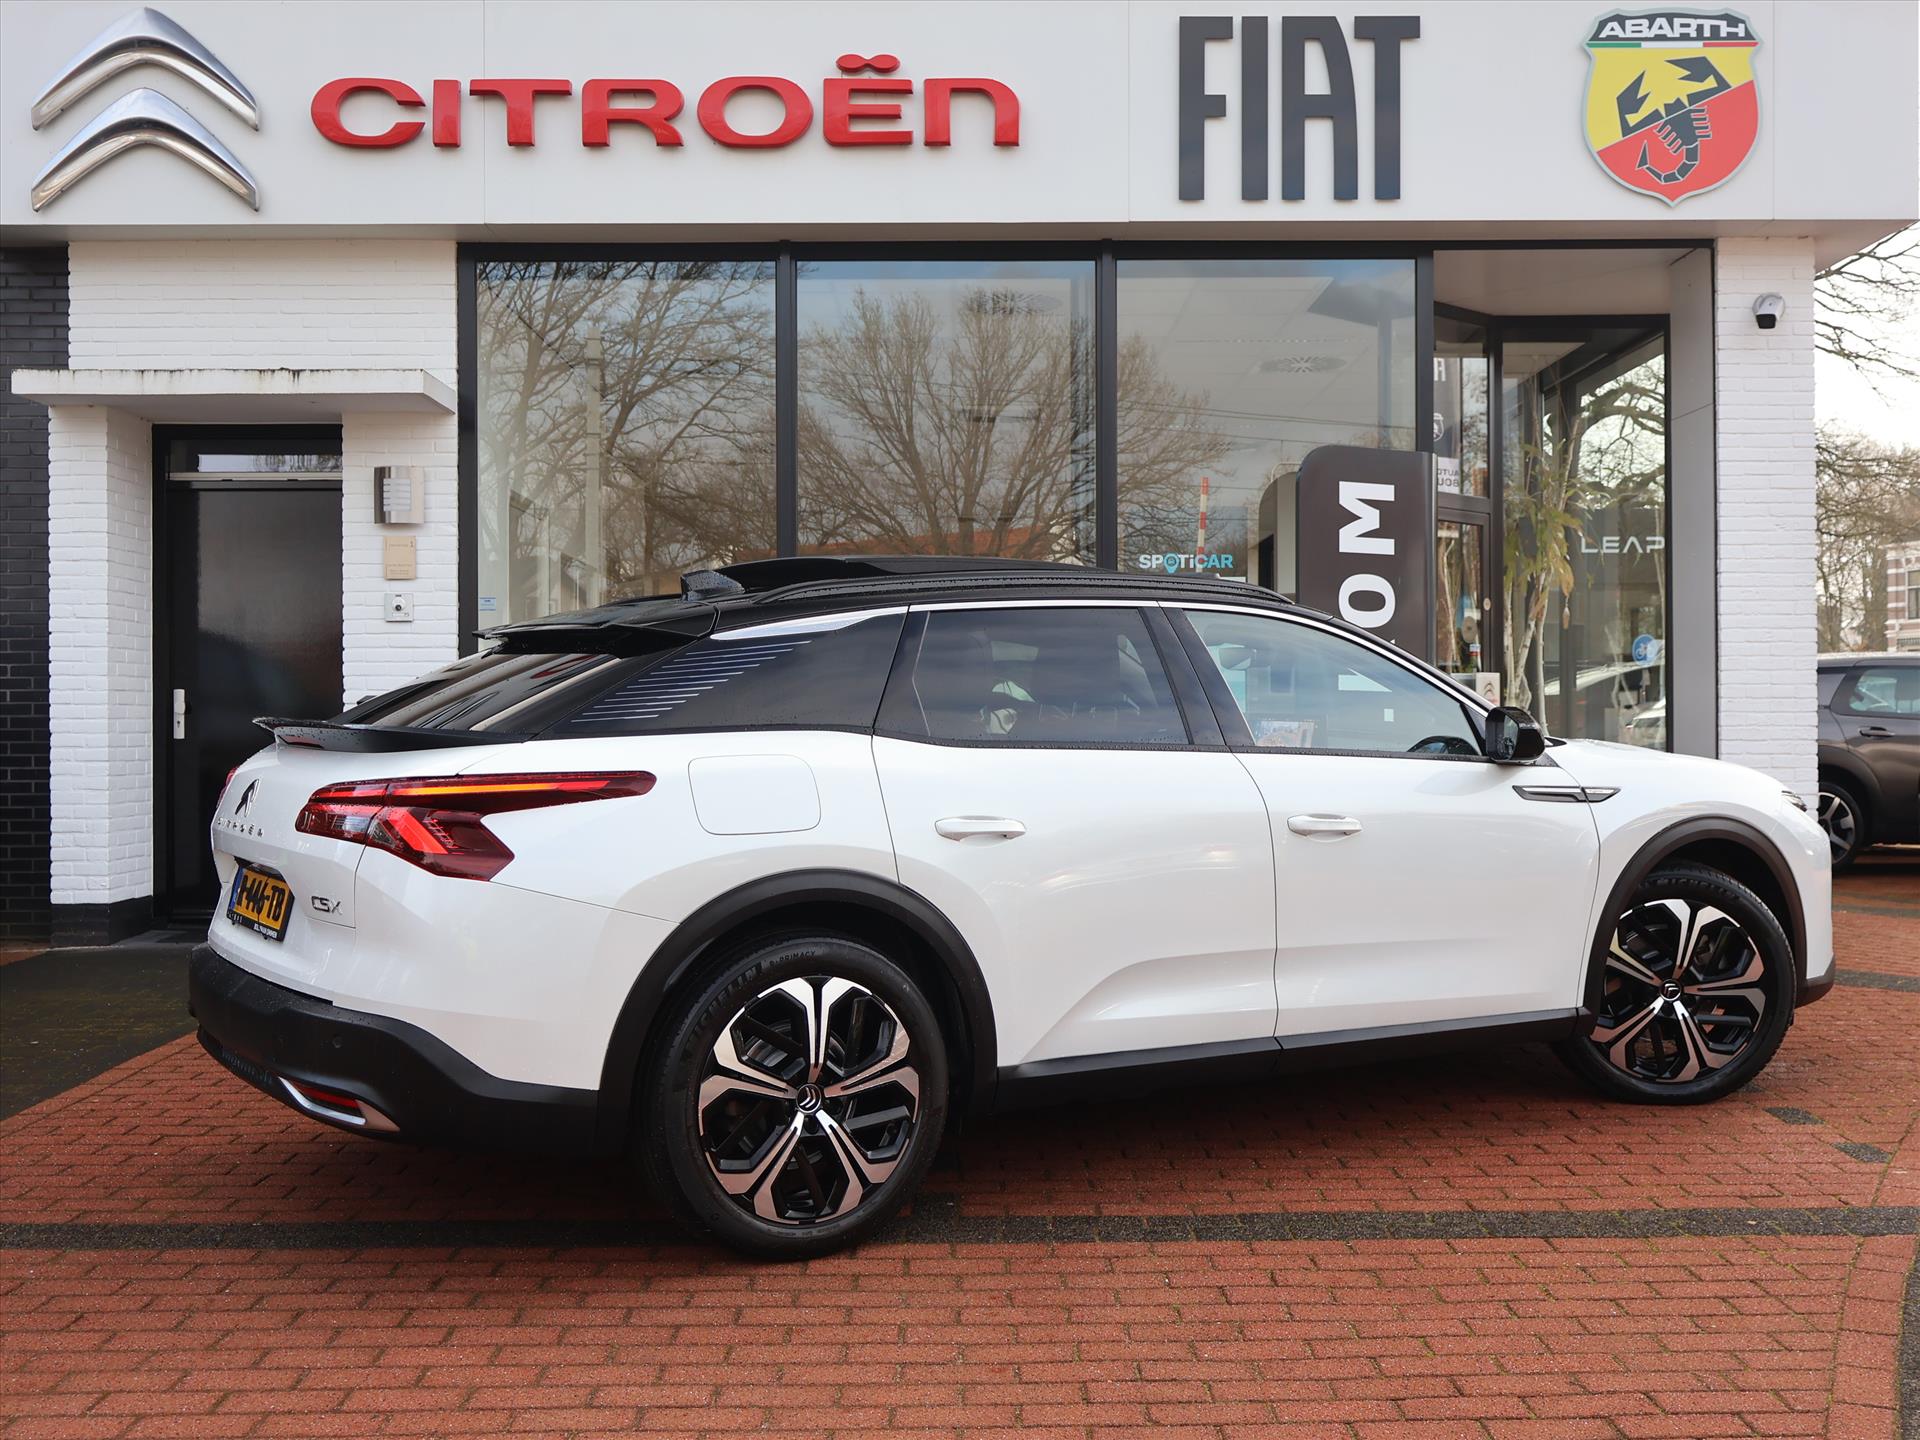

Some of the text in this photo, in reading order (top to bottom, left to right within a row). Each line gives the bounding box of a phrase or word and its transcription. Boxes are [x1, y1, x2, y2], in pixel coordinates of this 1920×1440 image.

[1599, 17, 1746, 38] ABARTH
[310, 53, 1021, 148] CITROËN
[1179, 16, 1420, 201] FIAT
[1581, 536, 1665, 554] LEAP
